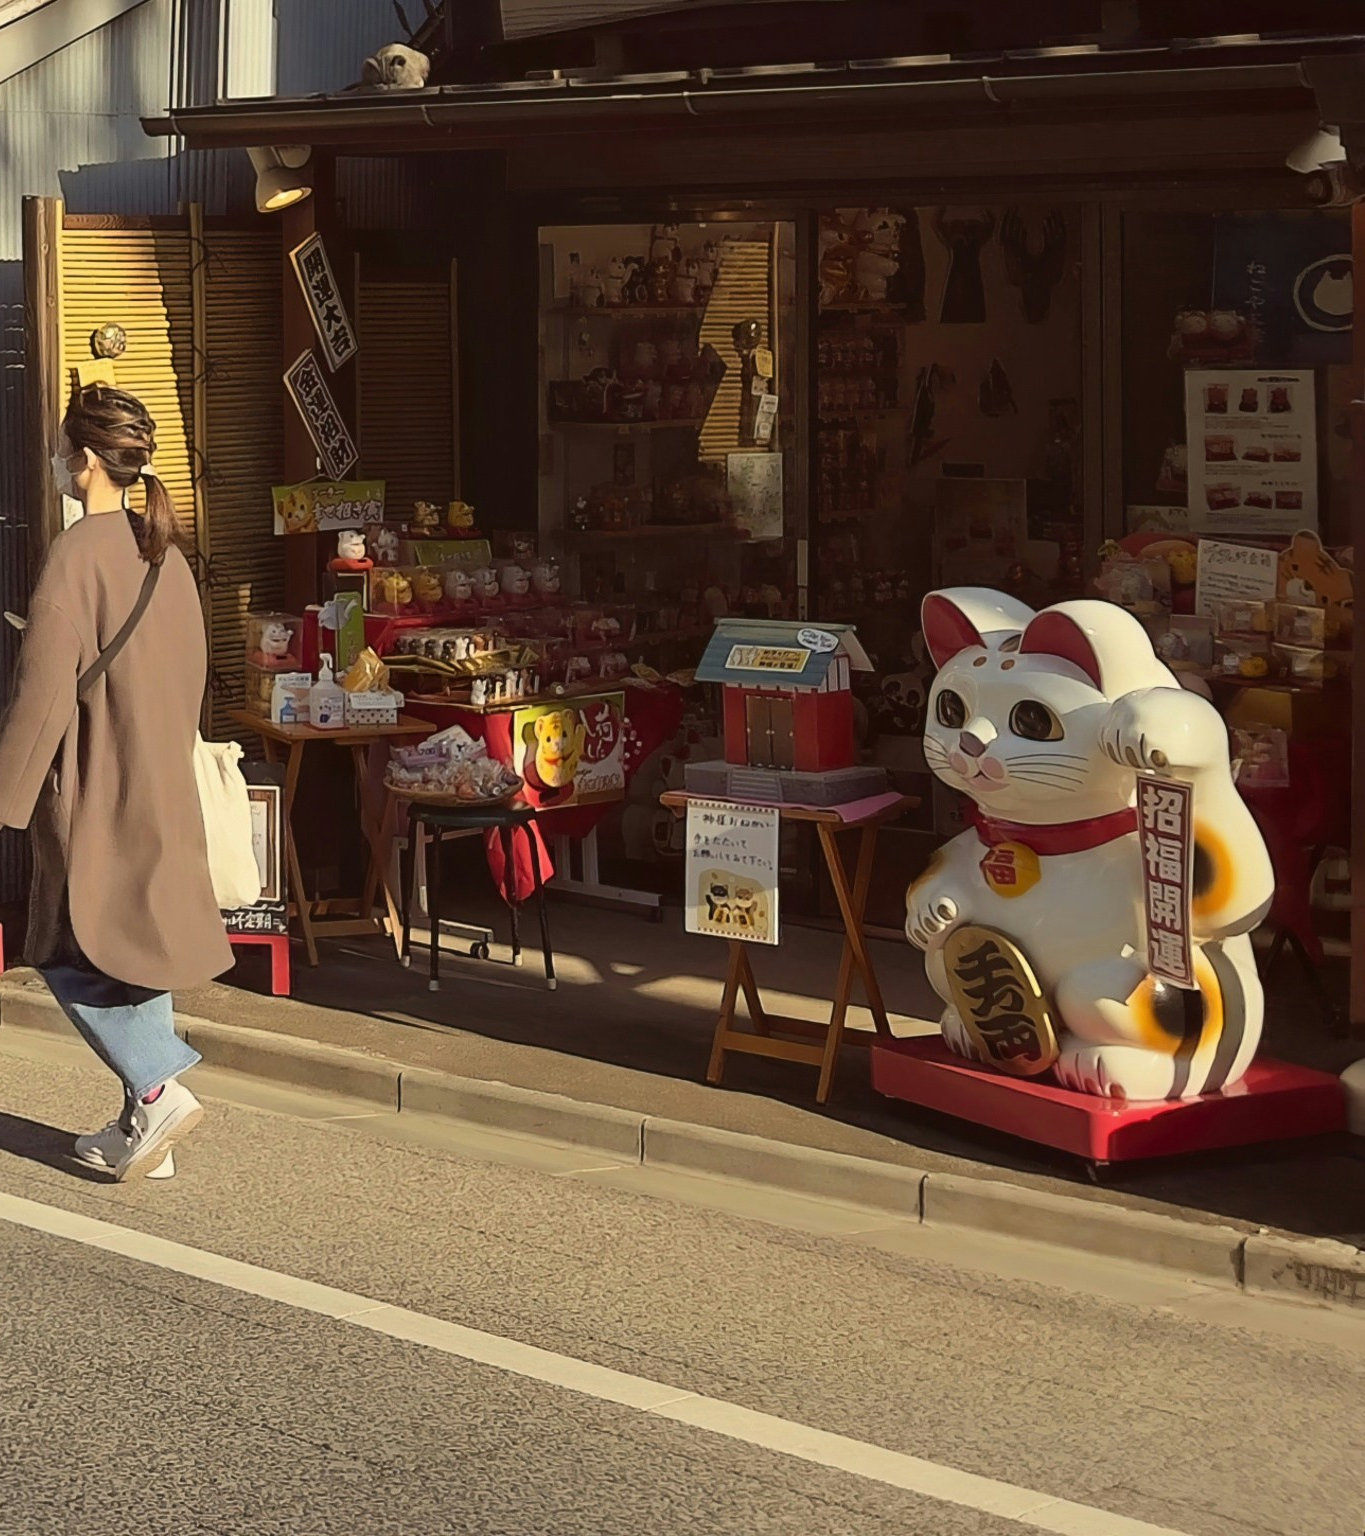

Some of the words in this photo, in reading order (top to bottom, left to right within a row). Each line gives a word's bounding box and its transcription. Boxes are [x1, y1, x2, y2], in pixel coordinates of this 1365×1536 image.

[303, 246, 351, 357] 開運大吉
[1142, 785, 1186, 978] 招福開運
